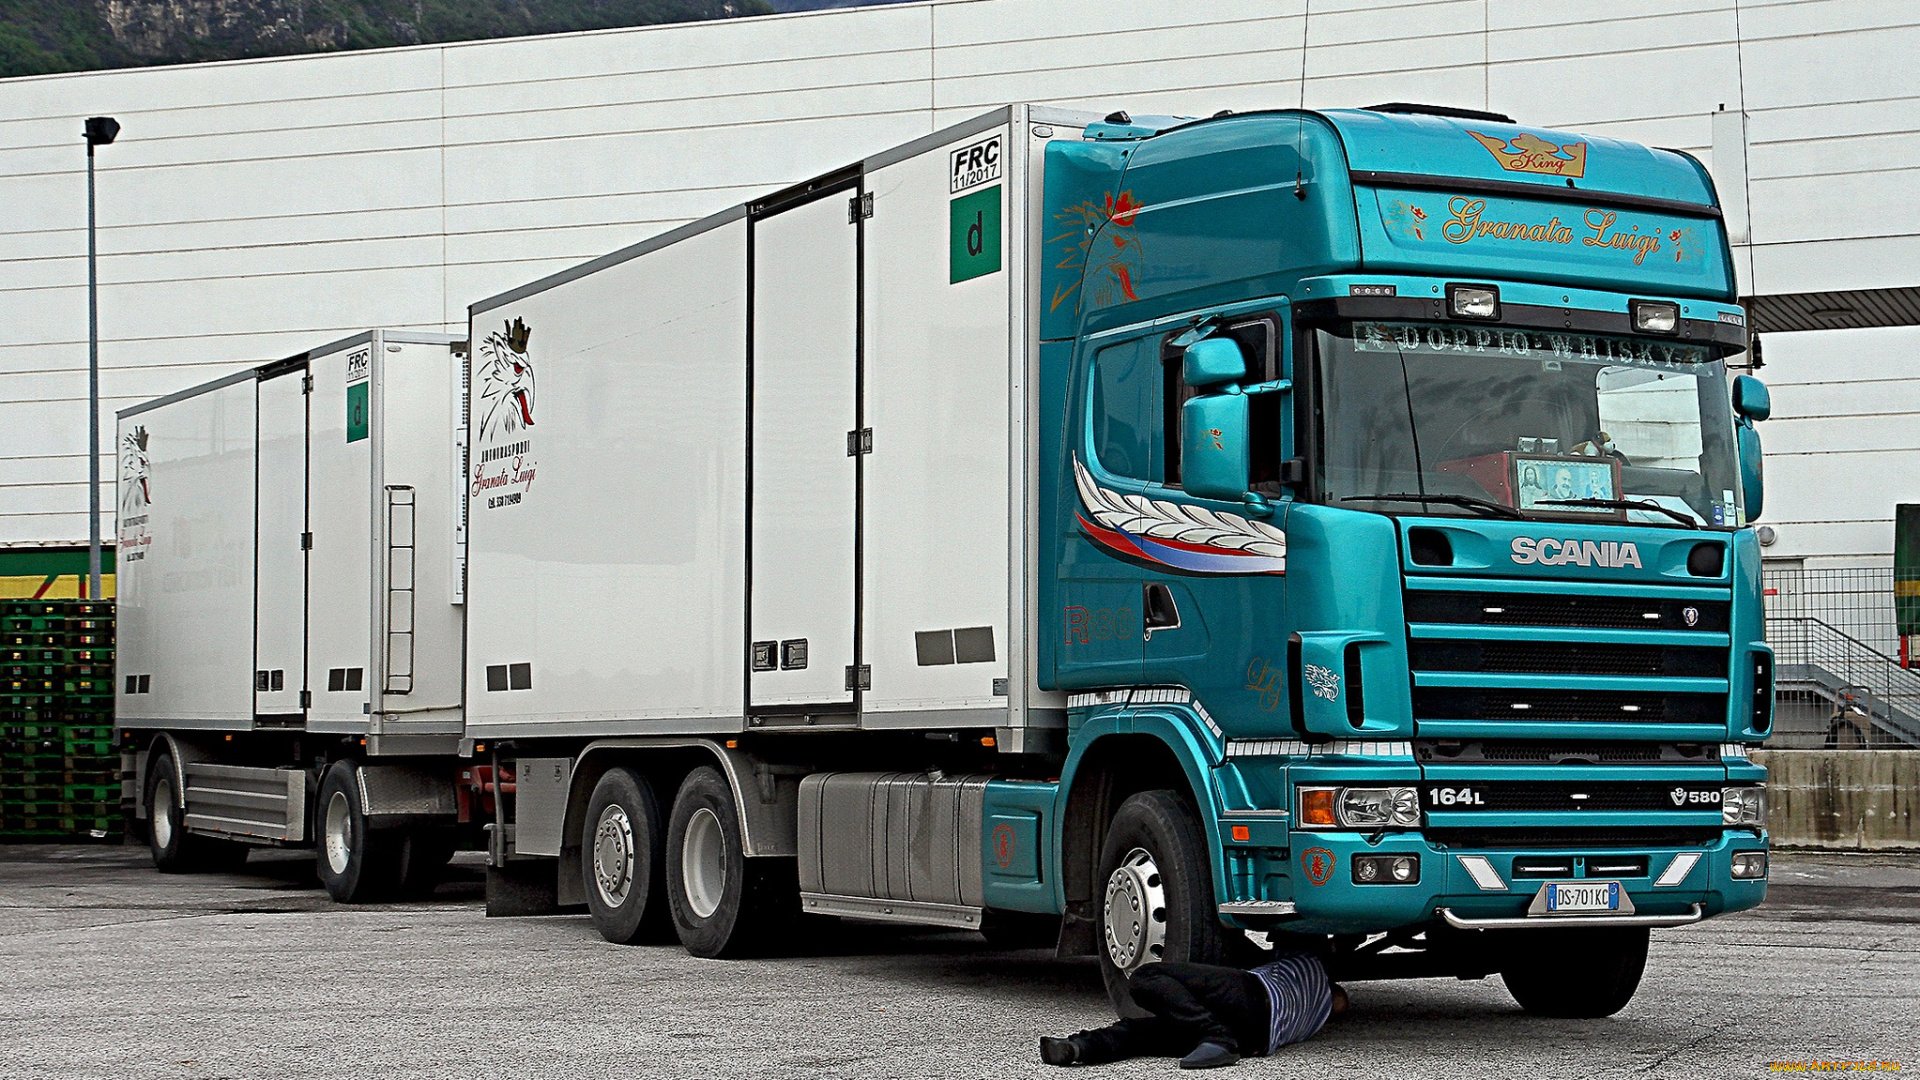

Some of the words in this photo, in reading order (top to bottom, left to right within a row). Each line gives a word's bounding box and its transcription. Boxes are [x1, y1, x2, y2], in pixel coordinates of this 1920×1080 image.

[953, 140, 999, 176] FRC
[1509, 153, 1566, 174] King
[953, 163, 997, 189] 11/2017
[967, 210, 983, 256] d
[1442, 195, 1574, 244] Granata
[1582, 208, 1662, 266] Luigi
[348, 351, 369, 371] FRC
[471, 463, 509, 497] Granata
[511, 456, 538, 492] Luigi
[1510, 536, 1643, 569] SCANIA
[1688, 791, 1721, 803] 580
